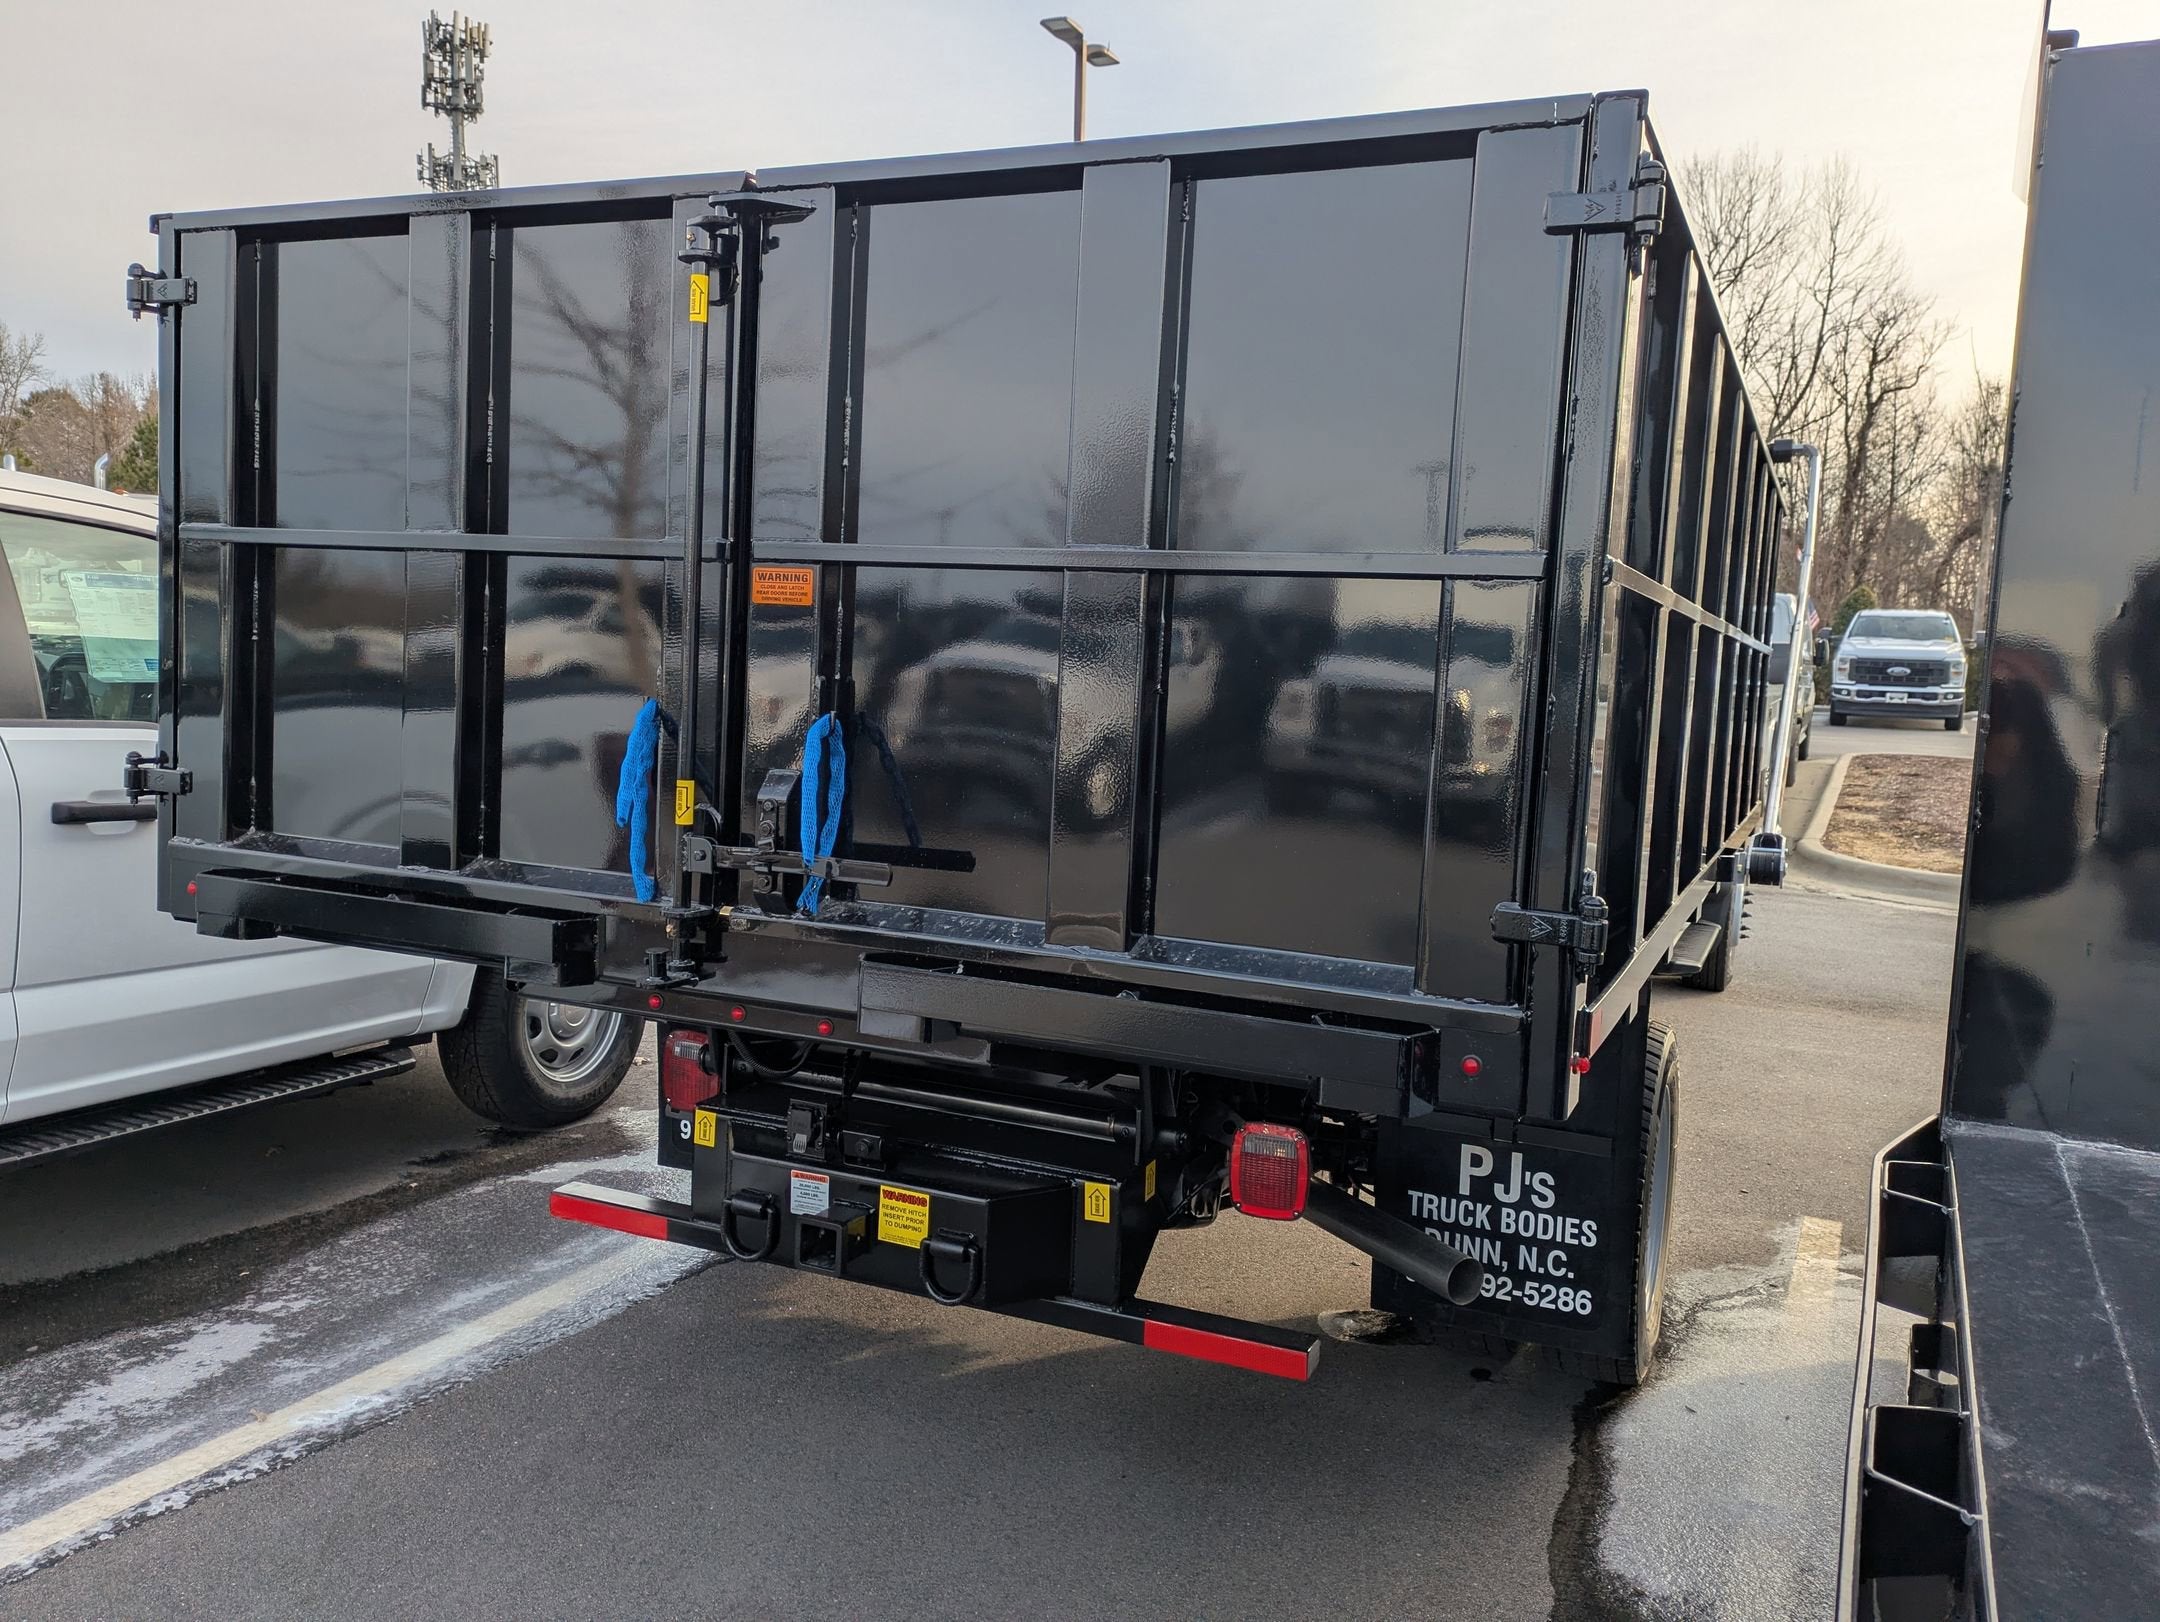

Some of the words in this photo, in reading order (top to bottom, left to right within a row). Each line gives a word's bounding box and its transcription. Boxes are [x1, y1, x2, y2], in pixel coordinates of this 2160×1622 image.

[757, 572, 809, 583] WARNING
[800, 1173, 826, 1182] WARNING
[1458, 1143, 1556, 1209] PJ'S
[882, 1189, 927, 1207] WARNING
[882, 1204, 907, 1214] REMOVE
[908, 1210, 926, 1218] HITCH
[1407, 1189, 1493, 1231] TRUCK
[1500, 1206, 1598, 1247] BODIES
[882, 1212, 905, 1221] INSERT
[906, 1216, 924, 1225] PRIOR
[894, 1222, 922, 1232] DUMPING
[1517, 1244, 1575, 1280] N.C.
